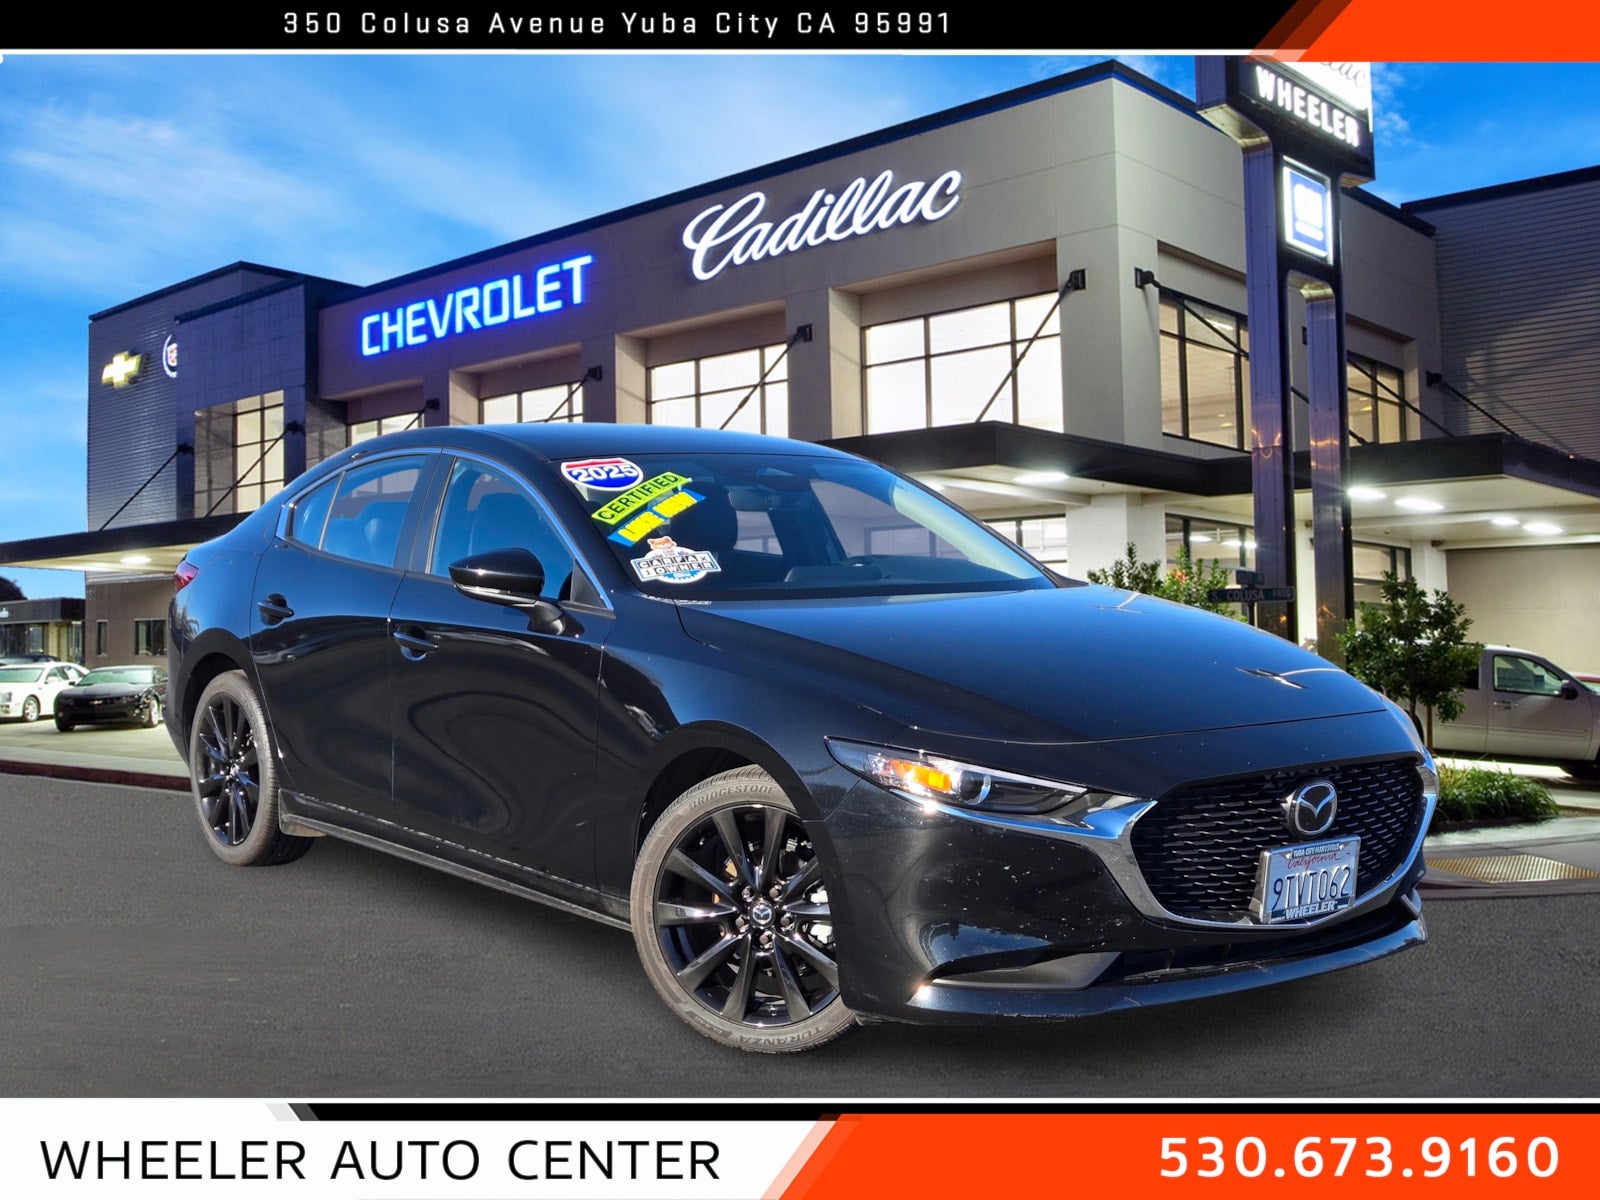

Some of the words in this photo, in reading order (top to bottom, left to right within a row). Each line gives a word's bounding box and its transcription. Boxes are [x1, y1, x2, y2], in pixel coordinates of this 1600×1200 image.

[1256, 65, 1359, 147] WHEELER
[683, 169, 963, 281] Cadillac
[361, 255, 594, 356] CHEVROLET
[571, 463, 638, 483] 2025
[597, 473, 679, 520] CERTIFIED
[637, 554, 712, 569] CARFAX
[654, 561, 715, 575] OWNER
[1226, 588, 1265, 601] COLUSA
[688, 784, 776, 811] BRIDGESTONE
[1287, 852, 1342, 870] California
[1271, 864, 1351, 911] 9TVT062
[1285, 900, 1336, 920] WHEELER
[739, 1026, 823, 1046] TURANZA
